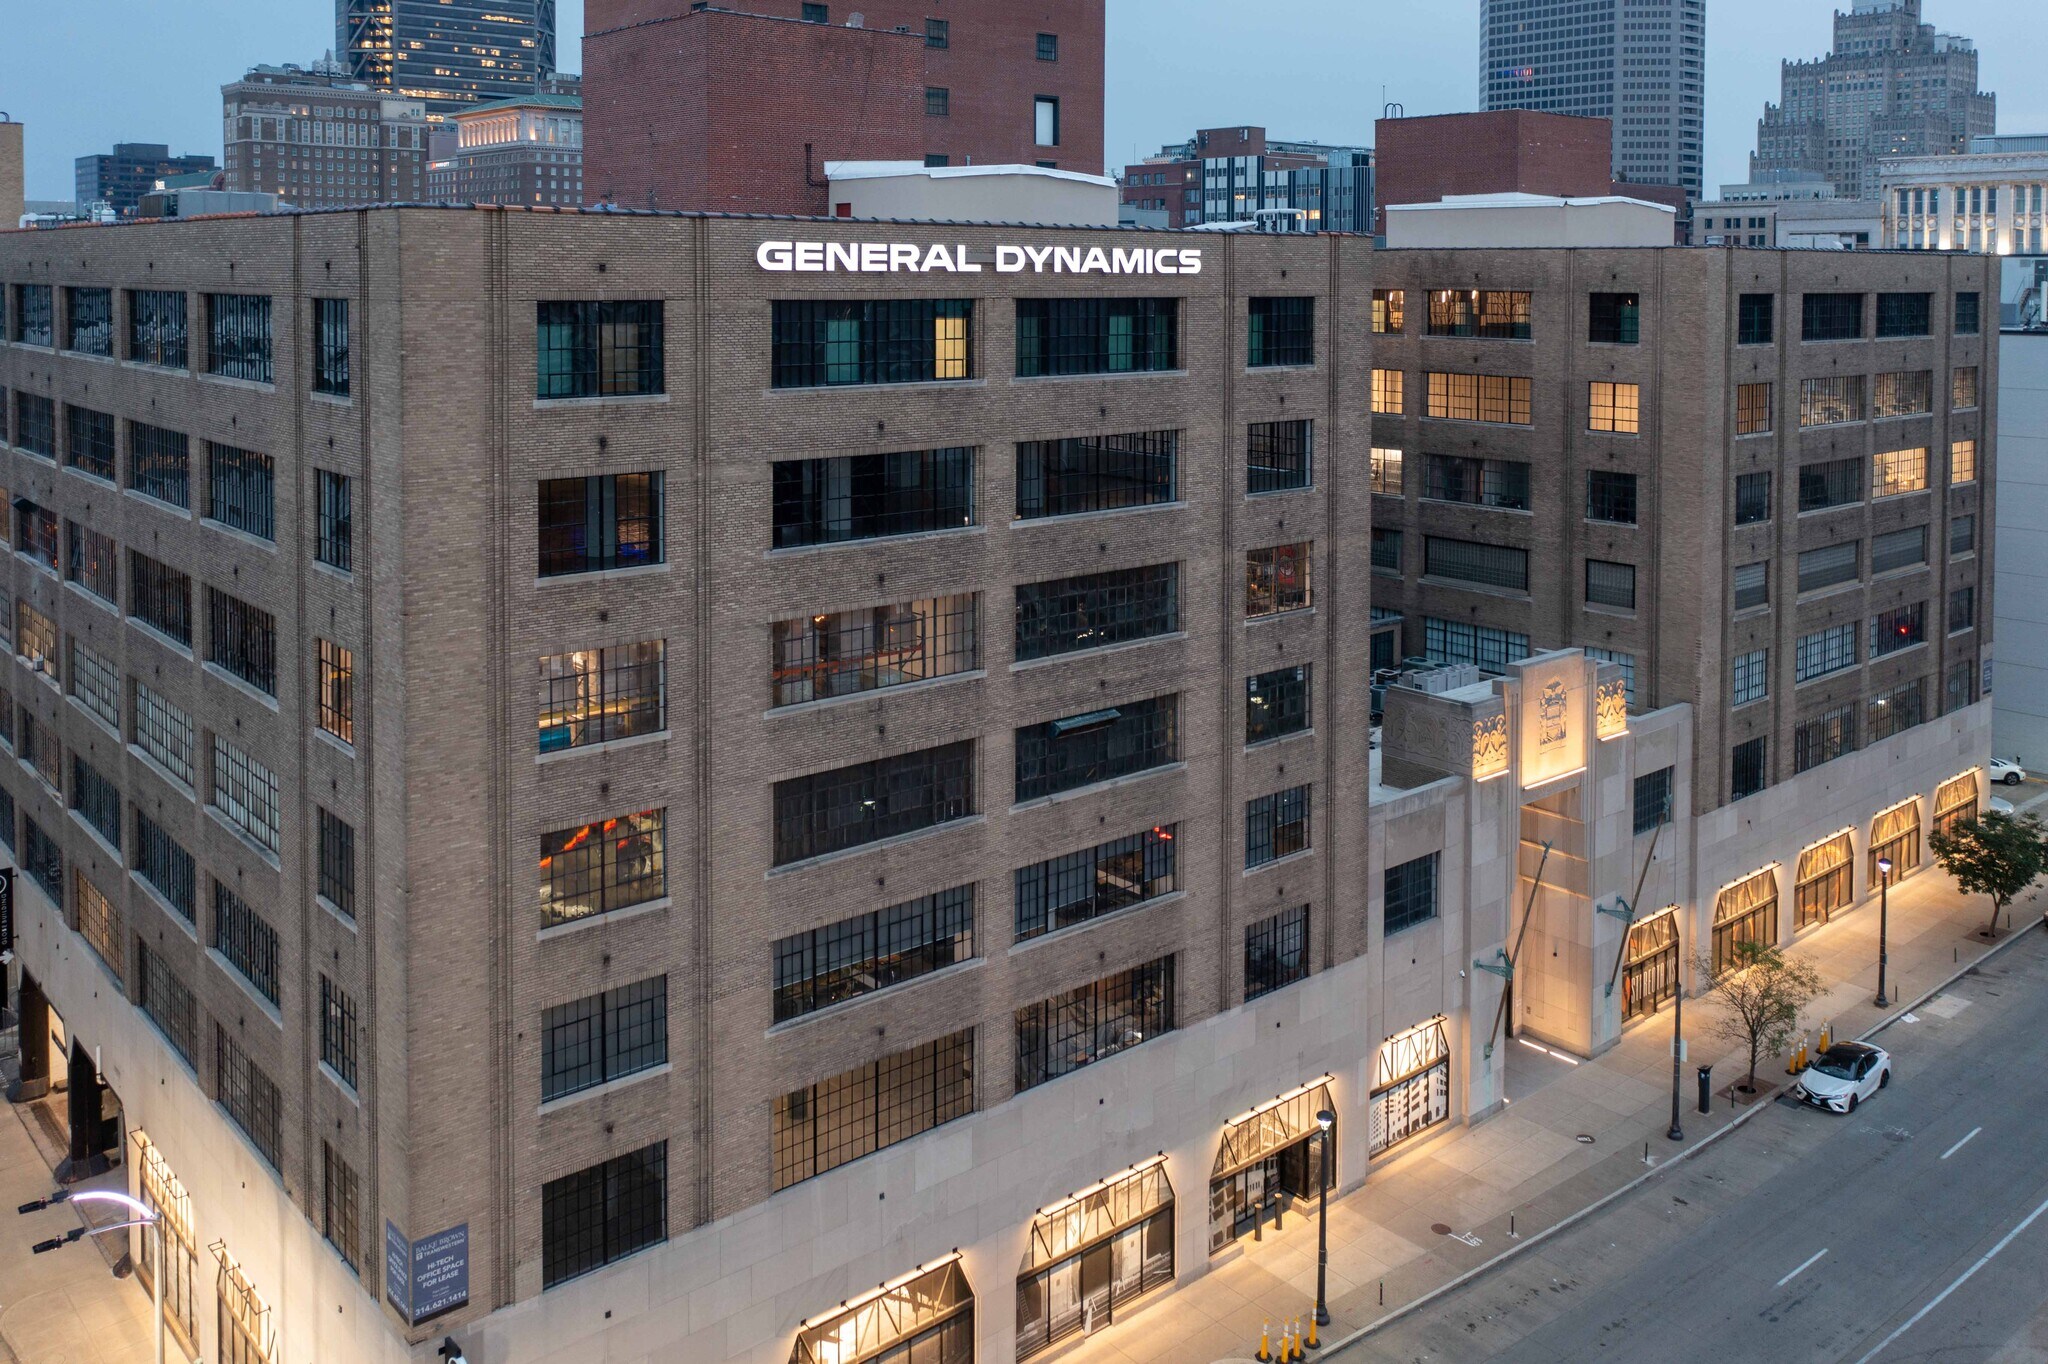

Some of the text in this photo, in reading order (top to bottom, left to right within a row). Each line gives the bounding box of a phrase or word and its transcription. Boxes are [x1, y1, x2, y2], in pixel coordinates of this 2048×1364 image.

[757, 241, 1201, 274] GENERAL DYNAMICS
[416, 1240, 438, 1254] BALKE
[439, 1231, 465, 1245] BROWN
[424, 1238, 465, 1257] TRANSWESTERN
[417, 1259, 465, 1282] OFFICE SPACE
[427, 1255, 454, 1270] HI-TECH
[422, 1269, 459, 1289] FOR LEASE
[415, 1290, 467, 1316] 314.621.1414
